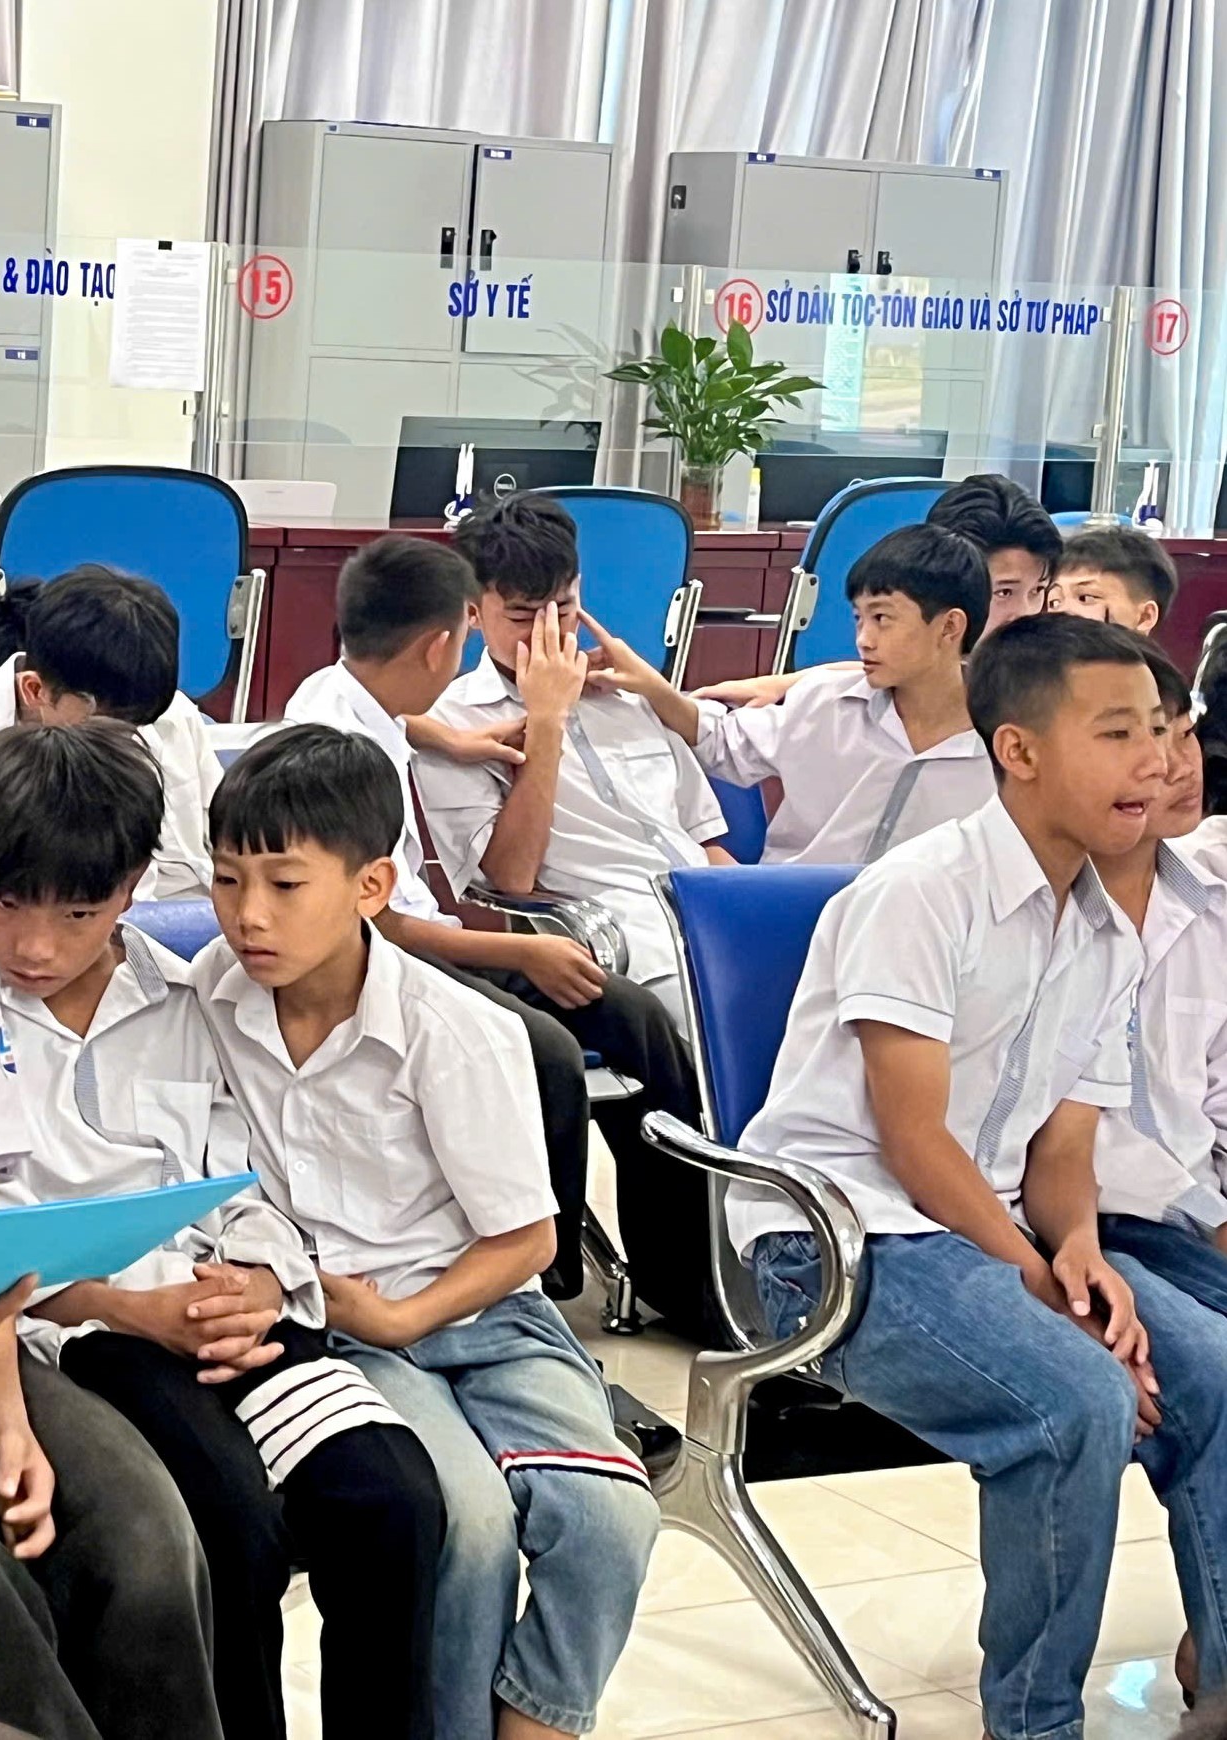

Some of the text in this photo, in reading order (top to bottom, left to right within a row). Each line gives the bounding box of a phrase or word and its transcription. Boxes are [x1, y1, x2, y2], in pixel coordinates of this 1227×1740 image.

[3, 257, 19, 293] &
[26, 247, 69, 296] ĐÀO
[80, 262, 116, 307] TẠO
[250, 270, 282, 305] 15
[448, 269, 533, 318] SỞ Y TẾ
[724, 293, 752, 325] 16
[766, 279, 792, 323] SỞ
[796, 284, 834, 325] DÂN
[922, 291, 963, 330] GIÁO
[970, 292, 991, 331] VÀ
[996, 290, 1021, 332] SỞ
[1027, 298, 1050, 333] TƯ
[1052, 297, 1099, 335] PHÁP
[1157, 312, 1179, 344] 17
